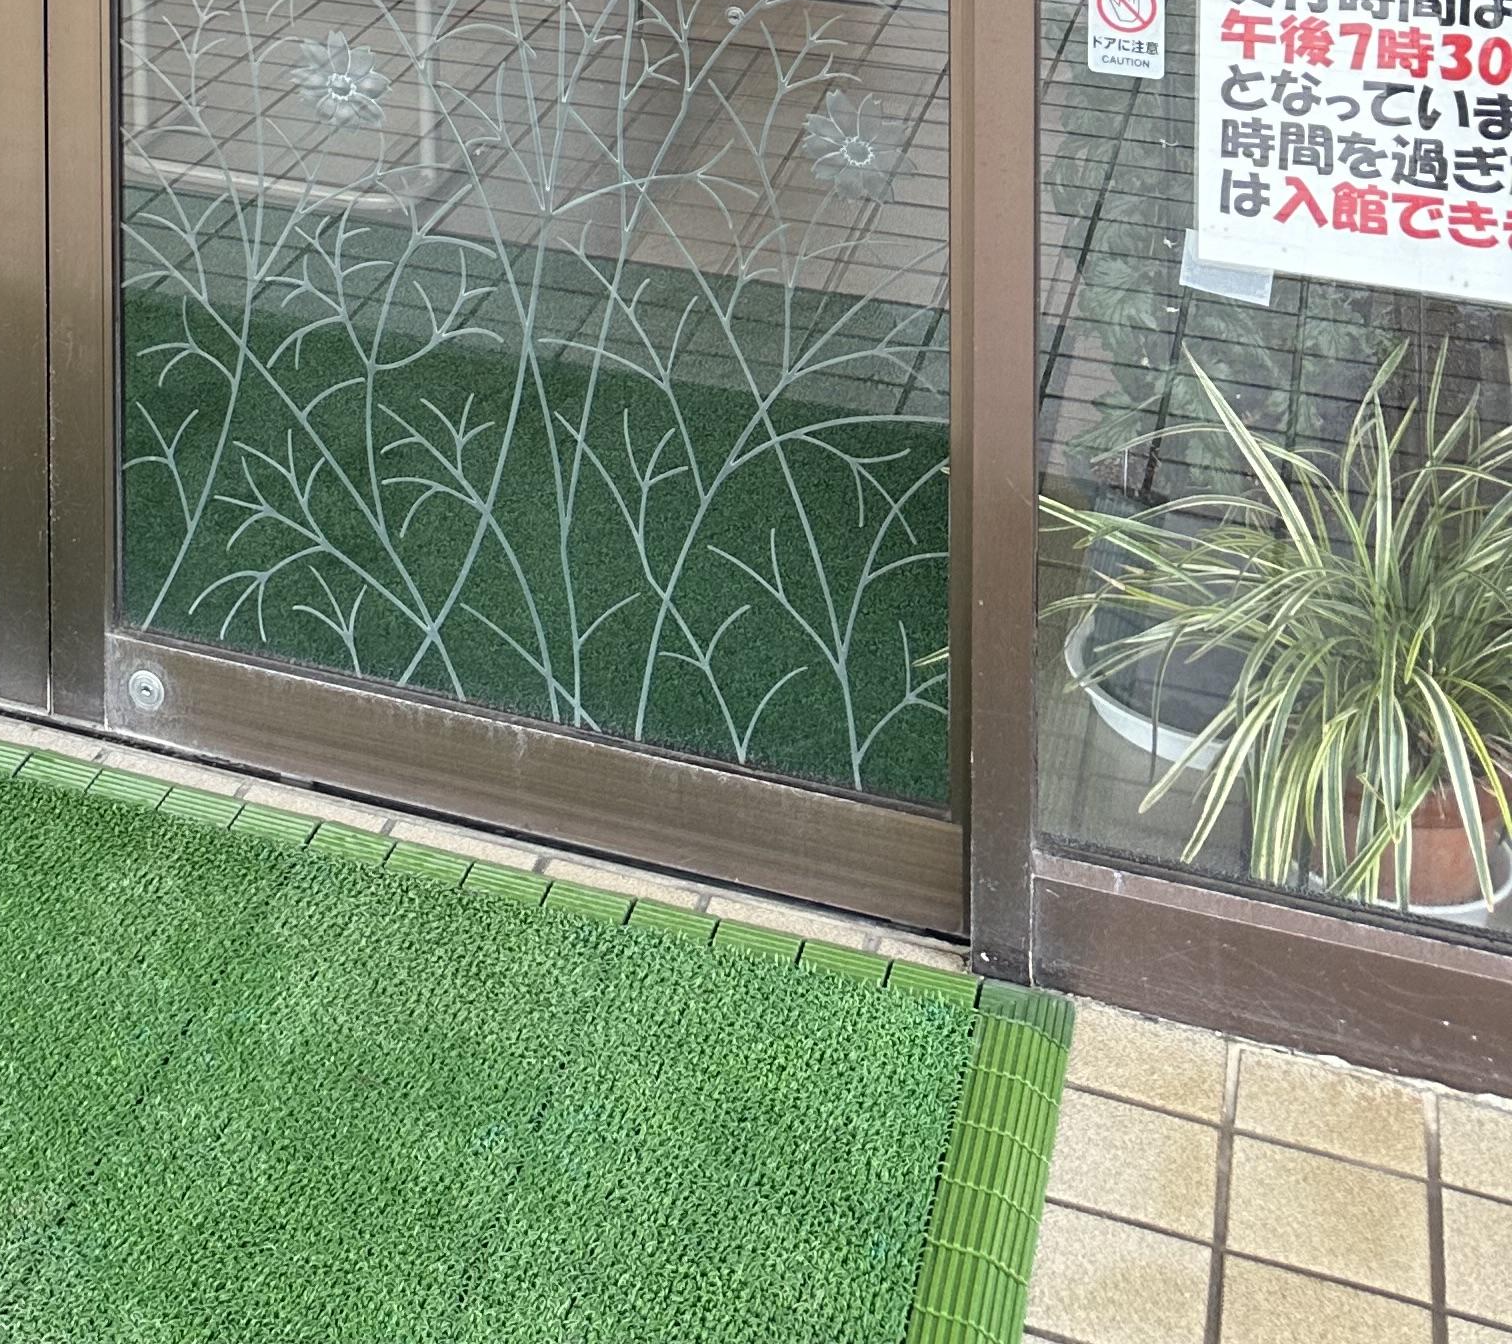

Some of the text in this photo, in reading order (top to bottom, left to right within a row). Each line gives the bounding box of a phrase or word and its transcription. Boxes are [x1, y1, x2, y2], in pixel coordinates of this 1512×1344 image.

[1092, 35, 1159, 56] ドアに注意
[1101, 54, 1150, 68] CAUTION
[1221, 8, 1512, 86] 午後7時30
[1220, 64, 1512, 141] となっていま
[1220, 116, 1512, 194] 時間を過ぎ
[1219, 168, 1512, 249] は入館でき
